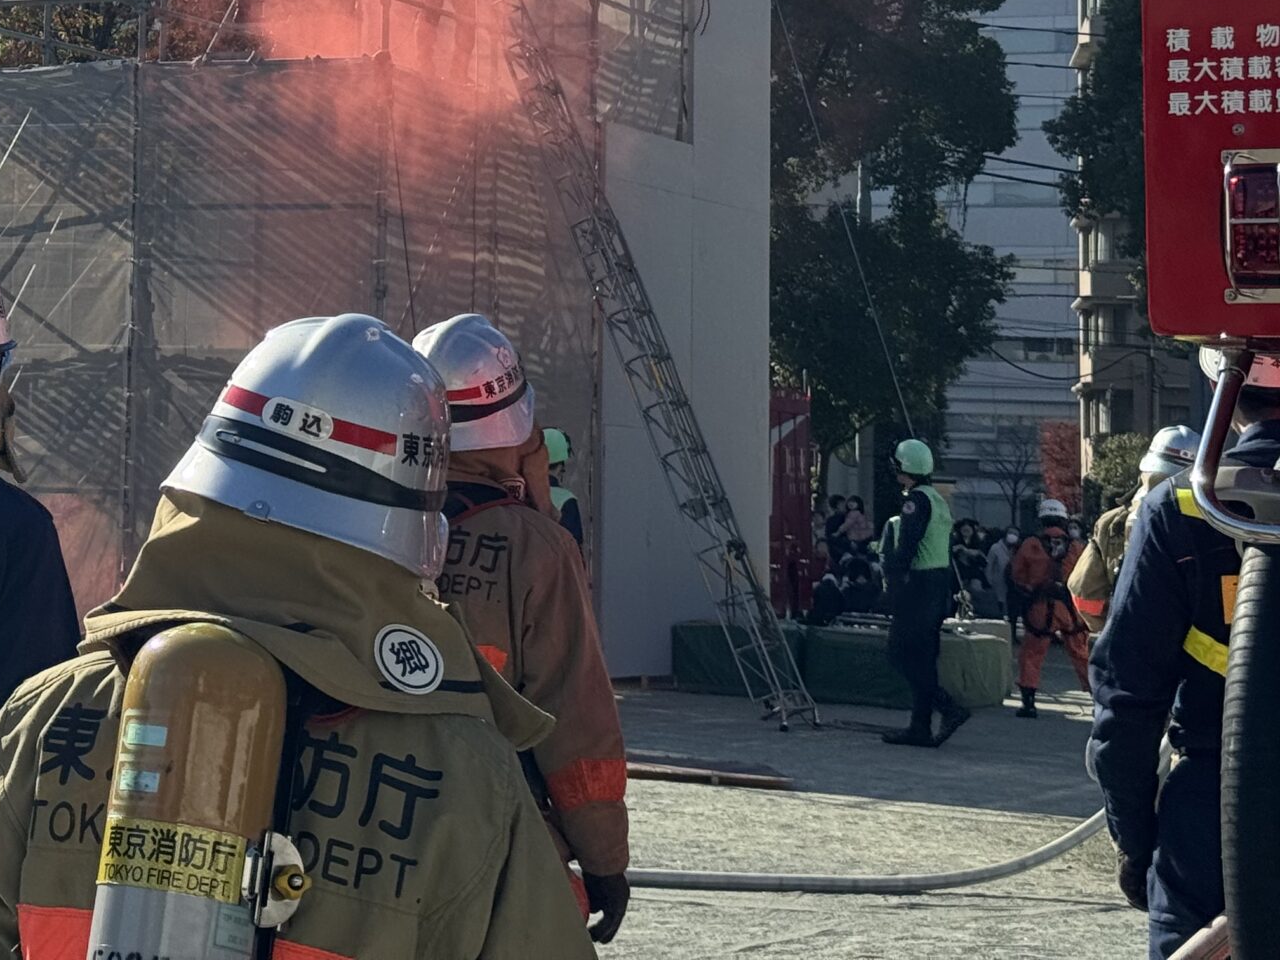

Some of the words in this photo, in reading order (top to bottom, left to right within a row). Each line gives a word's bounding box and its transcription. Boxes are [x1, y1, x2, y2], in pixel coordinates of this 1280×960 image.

[269, 402, 322, 438] 駒込
[106, 824, 237, 875] 東京消防庁
[104, 862, 144, 882] TOKYO
[146, 867, 184, 889] FIRE
[186, 874, 231, 900] DEPT.
